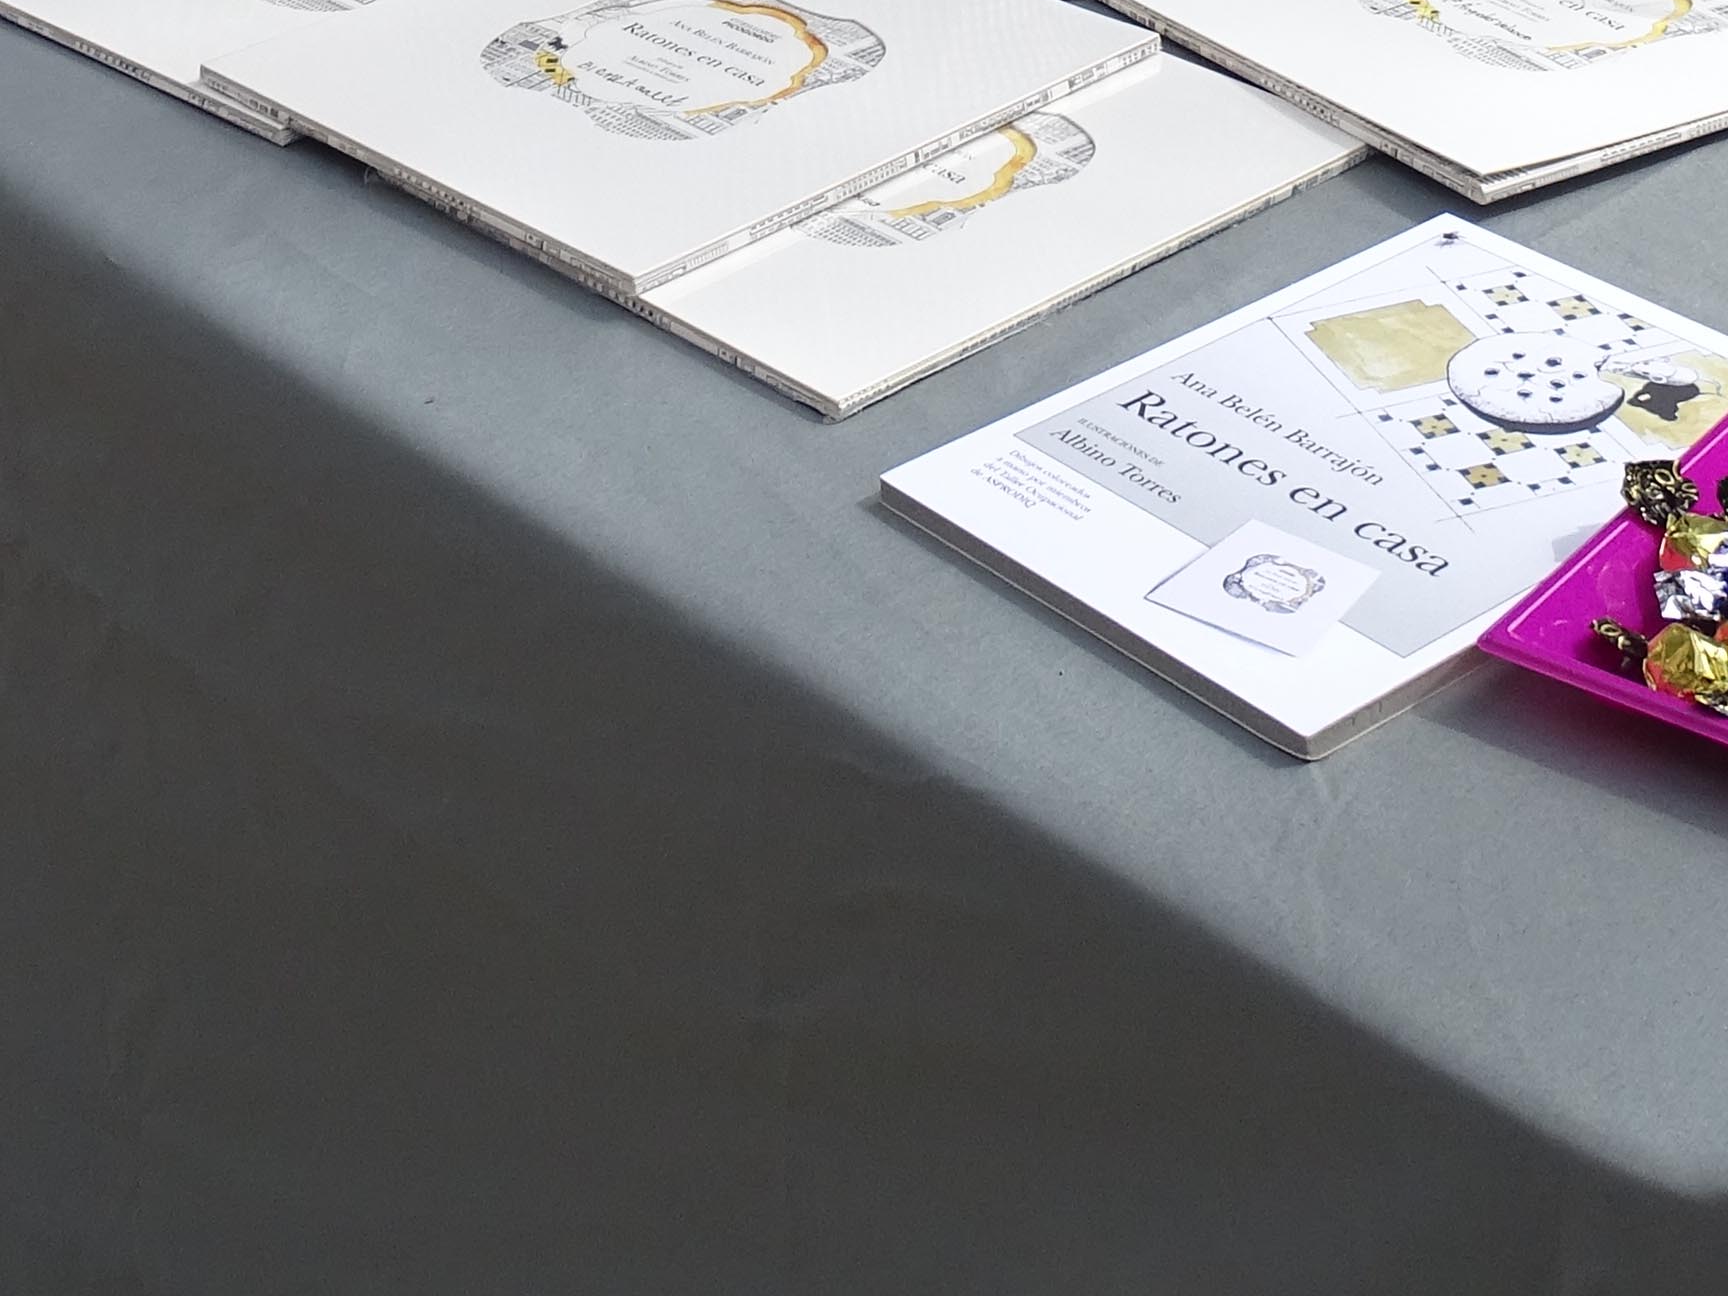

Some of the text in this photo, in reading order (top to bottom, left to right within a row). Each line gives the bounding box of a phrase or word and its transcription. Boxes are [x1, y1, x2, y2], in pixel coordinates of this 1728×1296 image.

[623, 21, 765, 87] Ratones en casa
[1585, 10, 1625, 31] casa
[1077, 417, 1166, 469] ILUSTRACIONES DE
[1171, 372, 1385, 488] Ana Belén Barrajón
[1049, 429, 1182, 504] Albino Torres
[1116, 389, 1451, 578] Ratones en casa
